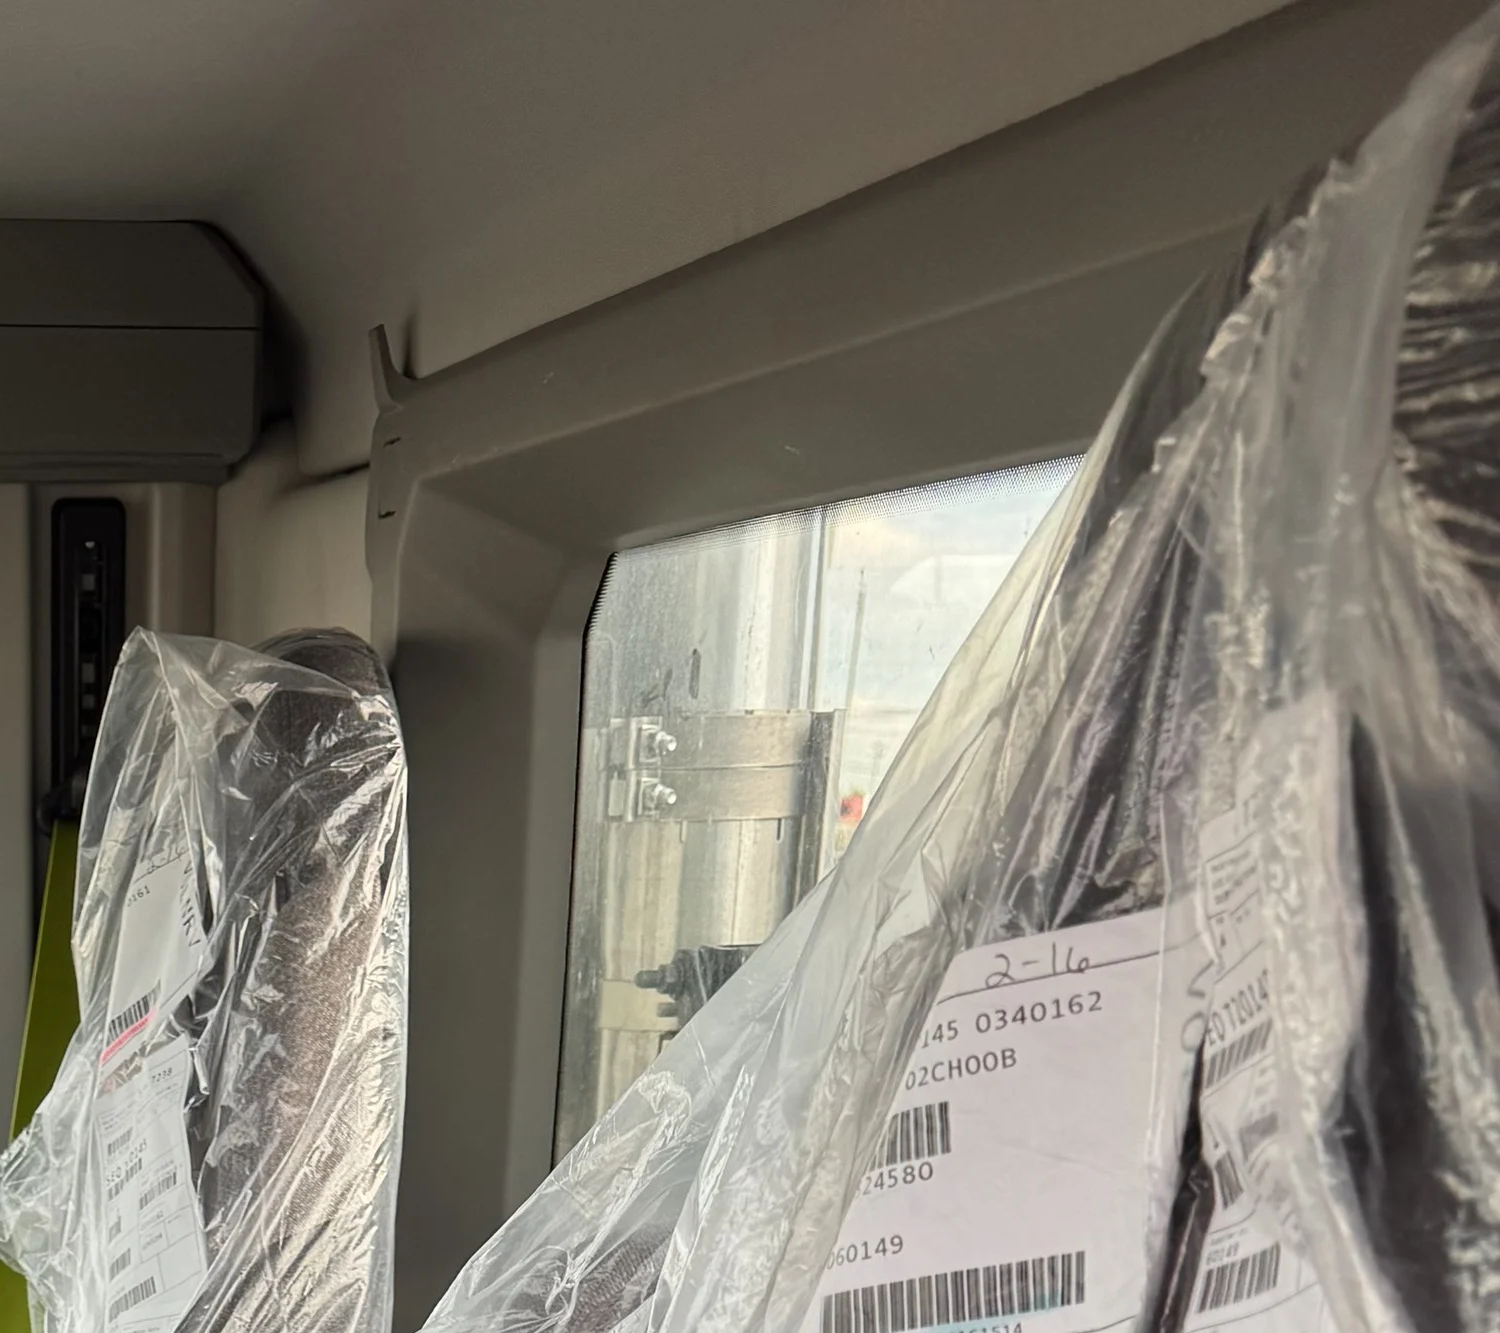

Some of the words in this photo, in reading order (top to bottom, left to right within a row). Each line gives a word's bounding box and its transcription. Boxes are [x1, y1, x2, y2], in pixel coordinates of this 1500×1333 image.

[984, 941, 1090, 989] 2-16
[975, 990, 1103, 1034] 0340162
[855, 1161, 934, 1197] 24580
